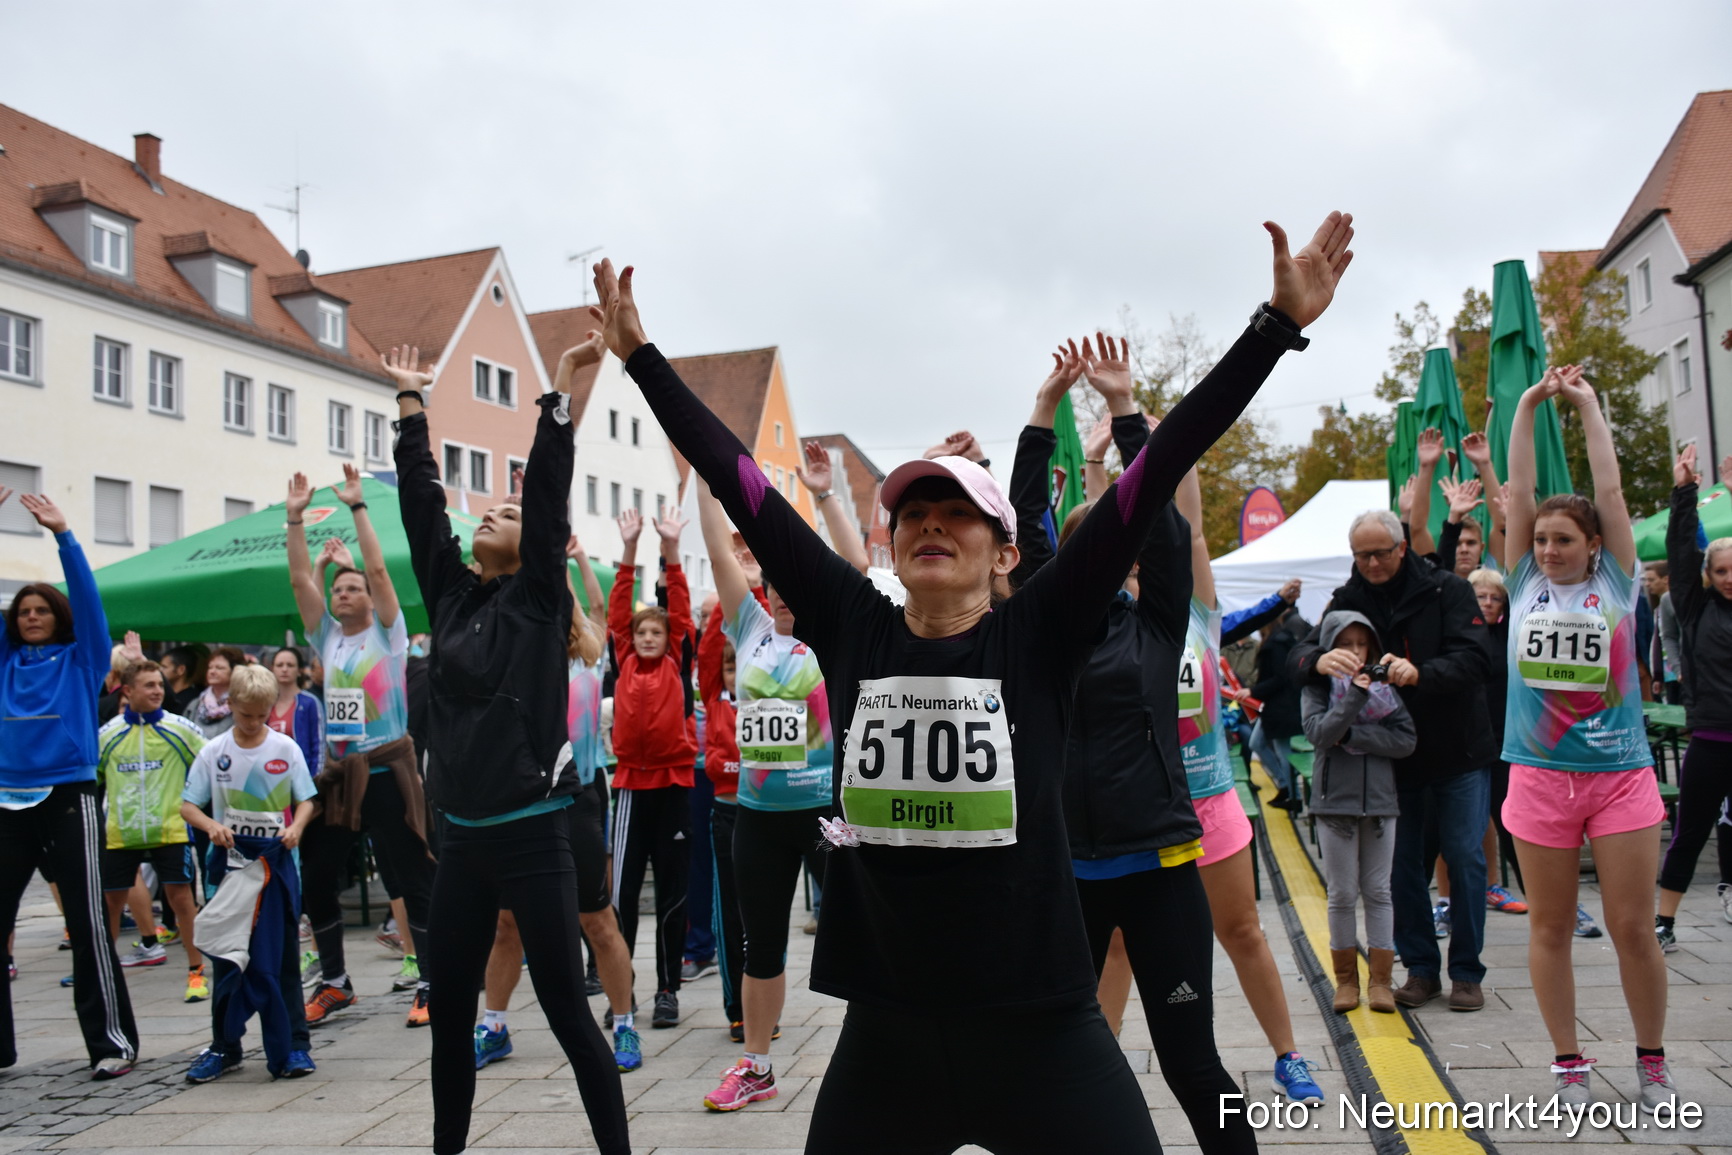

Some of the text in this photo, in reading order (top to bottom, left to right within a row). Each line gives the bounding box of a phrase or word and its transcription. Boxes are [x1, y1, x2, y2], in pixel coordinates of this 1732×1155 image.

[1551, 619, 1595, 630] Neumarkt
[1526, 630, 1602, 662] 5115
[1546, 666, 1575, 680] Lena
[857, 694, 979, 712] PARTL Neumarkt
[741, 715, 799, 743] 5103
[1585, 717, 1606, 730] 16.
[754, 749, 783, 762] Peggy
[857, 718, 999, 783] 5105
[1182, 745, 1200, 759] 16.
[1185, 762, 1214, 774] tadtlauf
[847, 774, 853, 785] S
[891, 798, 955, 829] Birgit
[1167, 992, 1199, 1004] adidas
